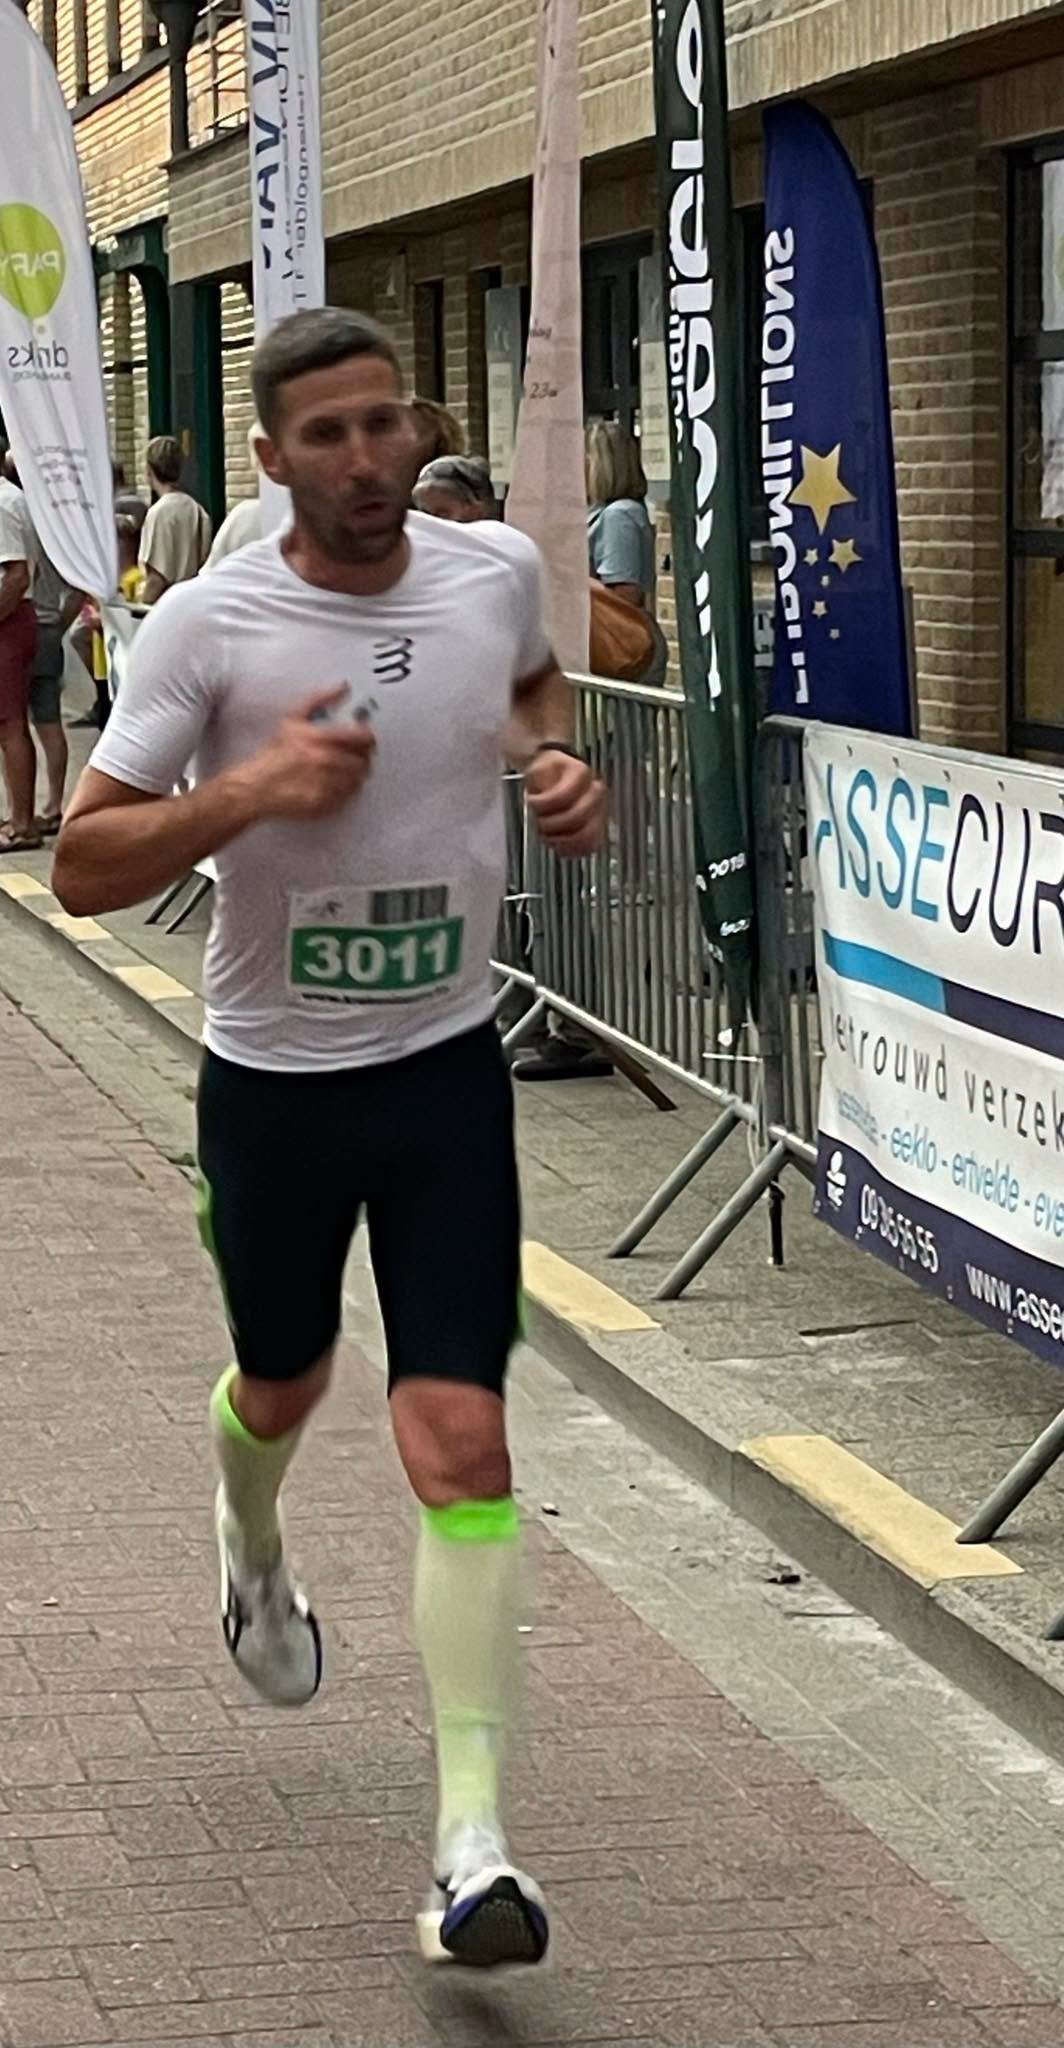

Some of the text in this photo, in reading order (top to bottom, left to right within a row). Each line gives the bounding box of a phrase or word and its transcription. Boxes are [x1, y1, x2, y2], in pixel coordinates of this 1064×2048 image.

[303, 929, 448, 983] 3011
[830, 1007, 948, 1101] etrouwd
[891, 1123, 937, 1173] eeklo
[965, 1262, 1064, 1343] www.asse
